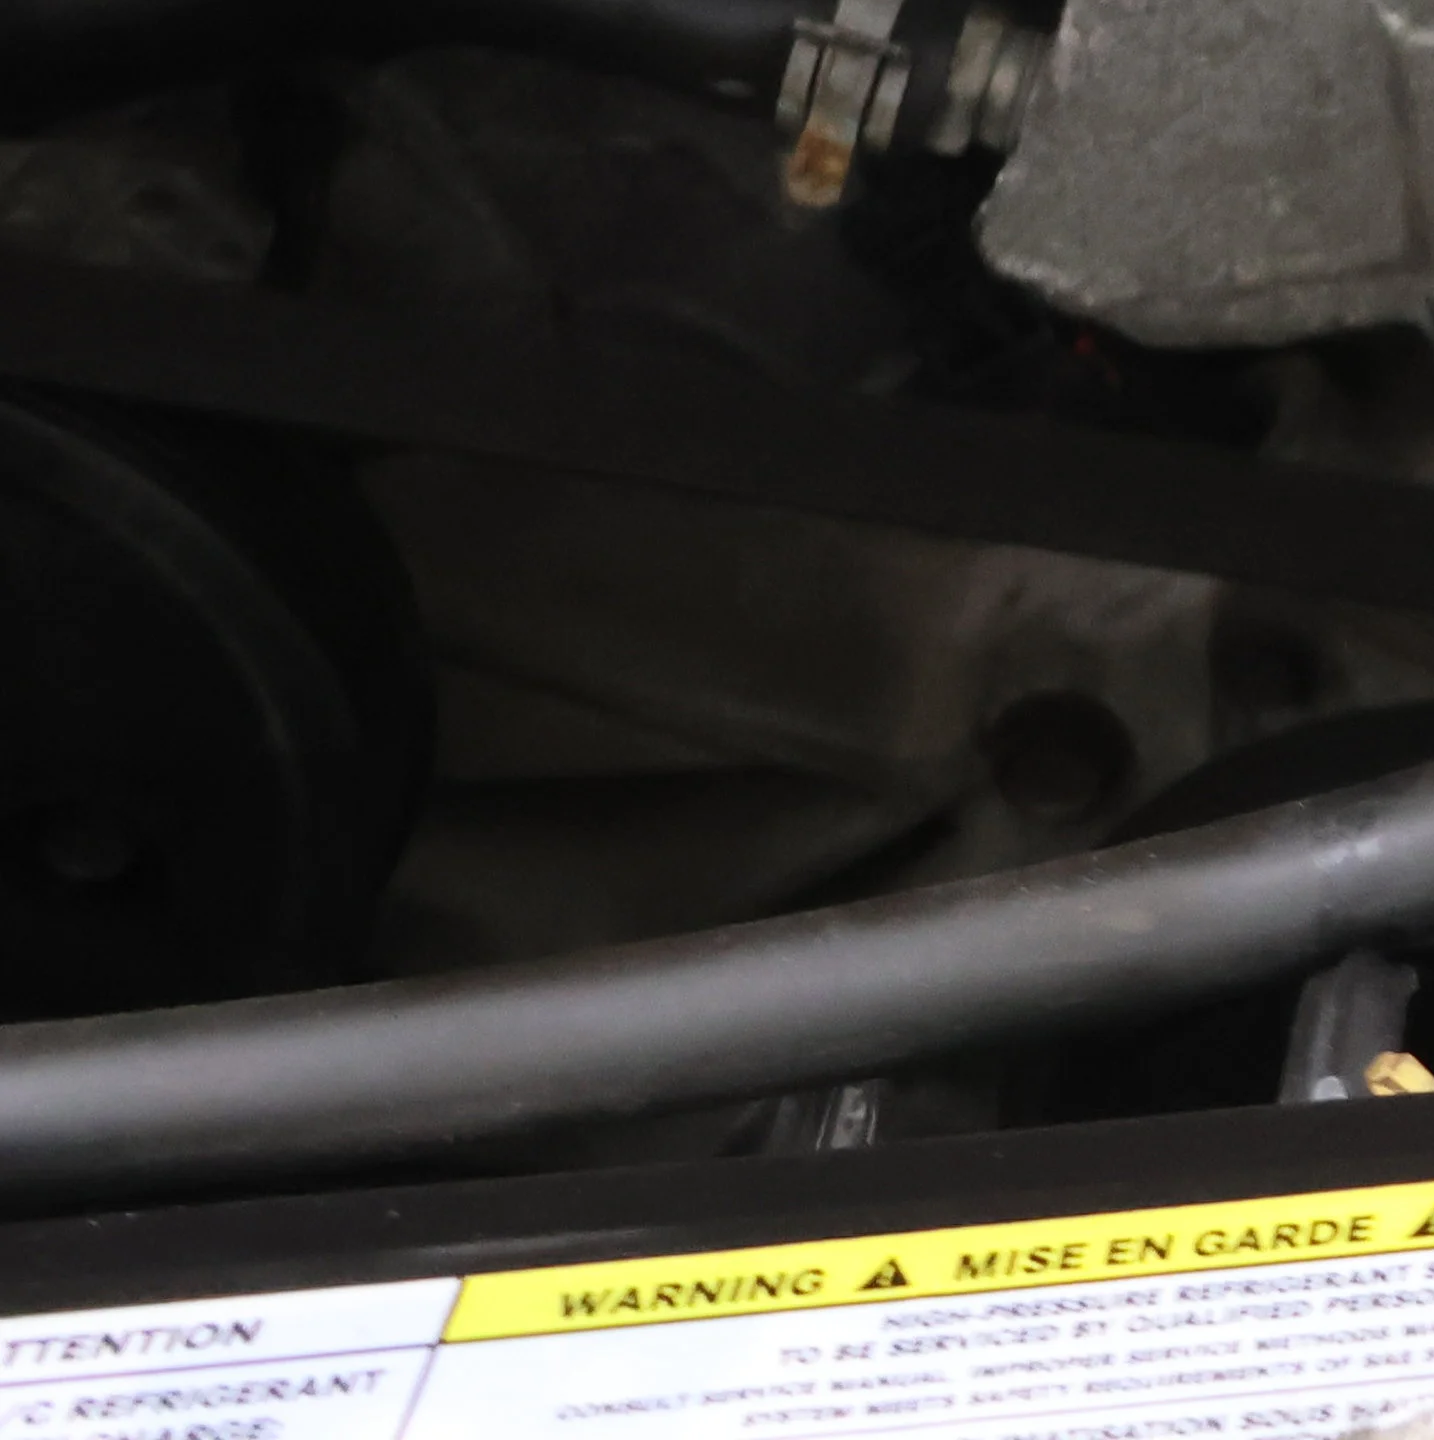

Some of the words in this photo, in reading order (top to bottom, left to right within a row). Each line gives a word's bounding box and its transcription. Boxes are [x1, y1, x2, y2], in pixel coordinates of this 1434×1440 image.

[558, 1267, 827, 1318] WARNING
[954, 1241, 1089, 1281] MISE
[1105, 1233, 1175, 1266] EN
[1193, 1214, 1377, 1258] GARDE
[1174, 1263, 1412, 1302] REFRIGERANT
[779, 1346, 822, 1365] TO
[834, 1340, 876, 1362] BE
[886, 1323, 1062, 1356] SERVICED
[1070, 1319, 1109, 1340] BY
[1126, 1299, 1314, 1333] QUALIFIED
[70, 1369, 386, 1421] REFRIGERANT
